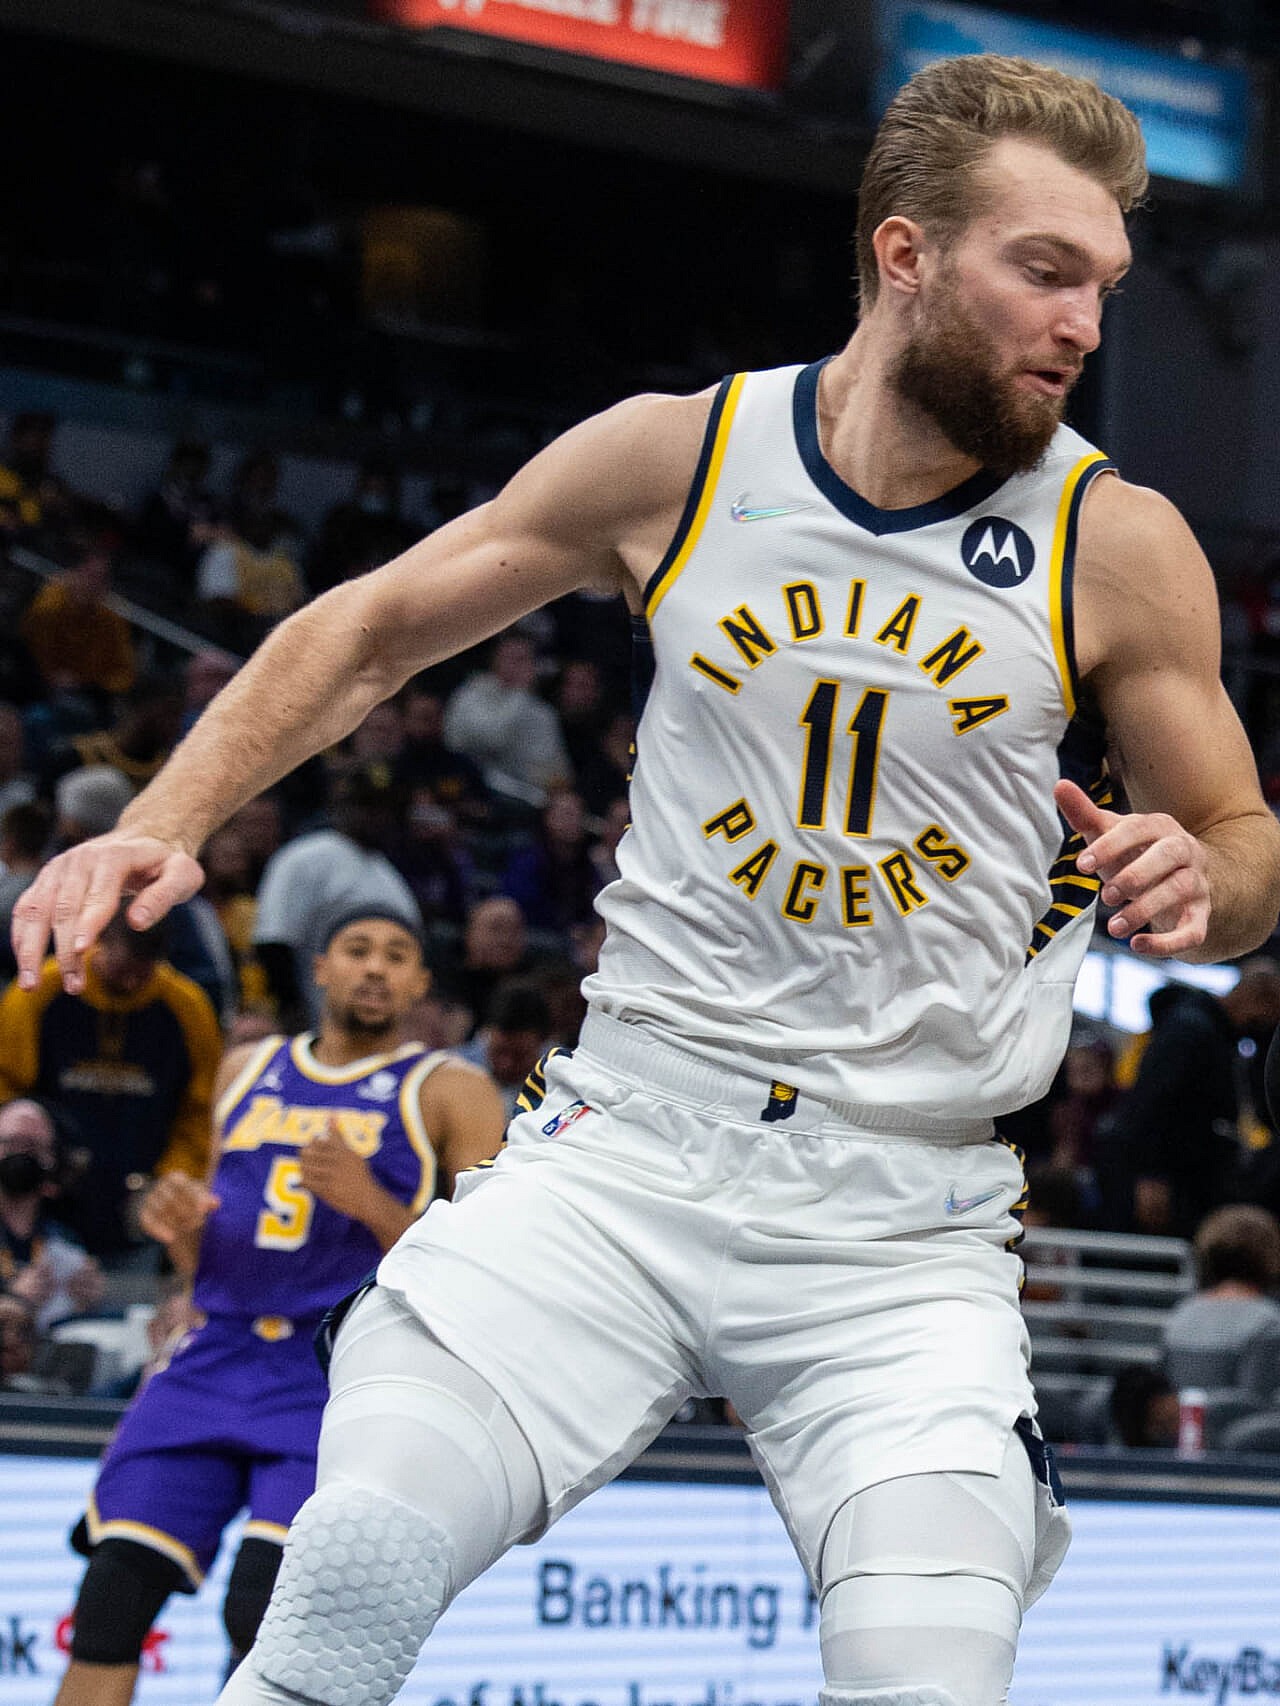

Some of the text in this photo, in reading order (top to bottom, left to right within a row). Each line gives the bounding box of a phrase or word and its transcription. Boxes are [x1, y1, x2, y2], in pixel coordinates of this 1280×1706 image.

[689, 578, 1010, 737] INDIANA
[799, 677, 890, 839] 11
[701, 796, 973, 928] PACERS
[254, 1156, 314, 1251] 5
[537, 1560, 780, 1649] Banking
